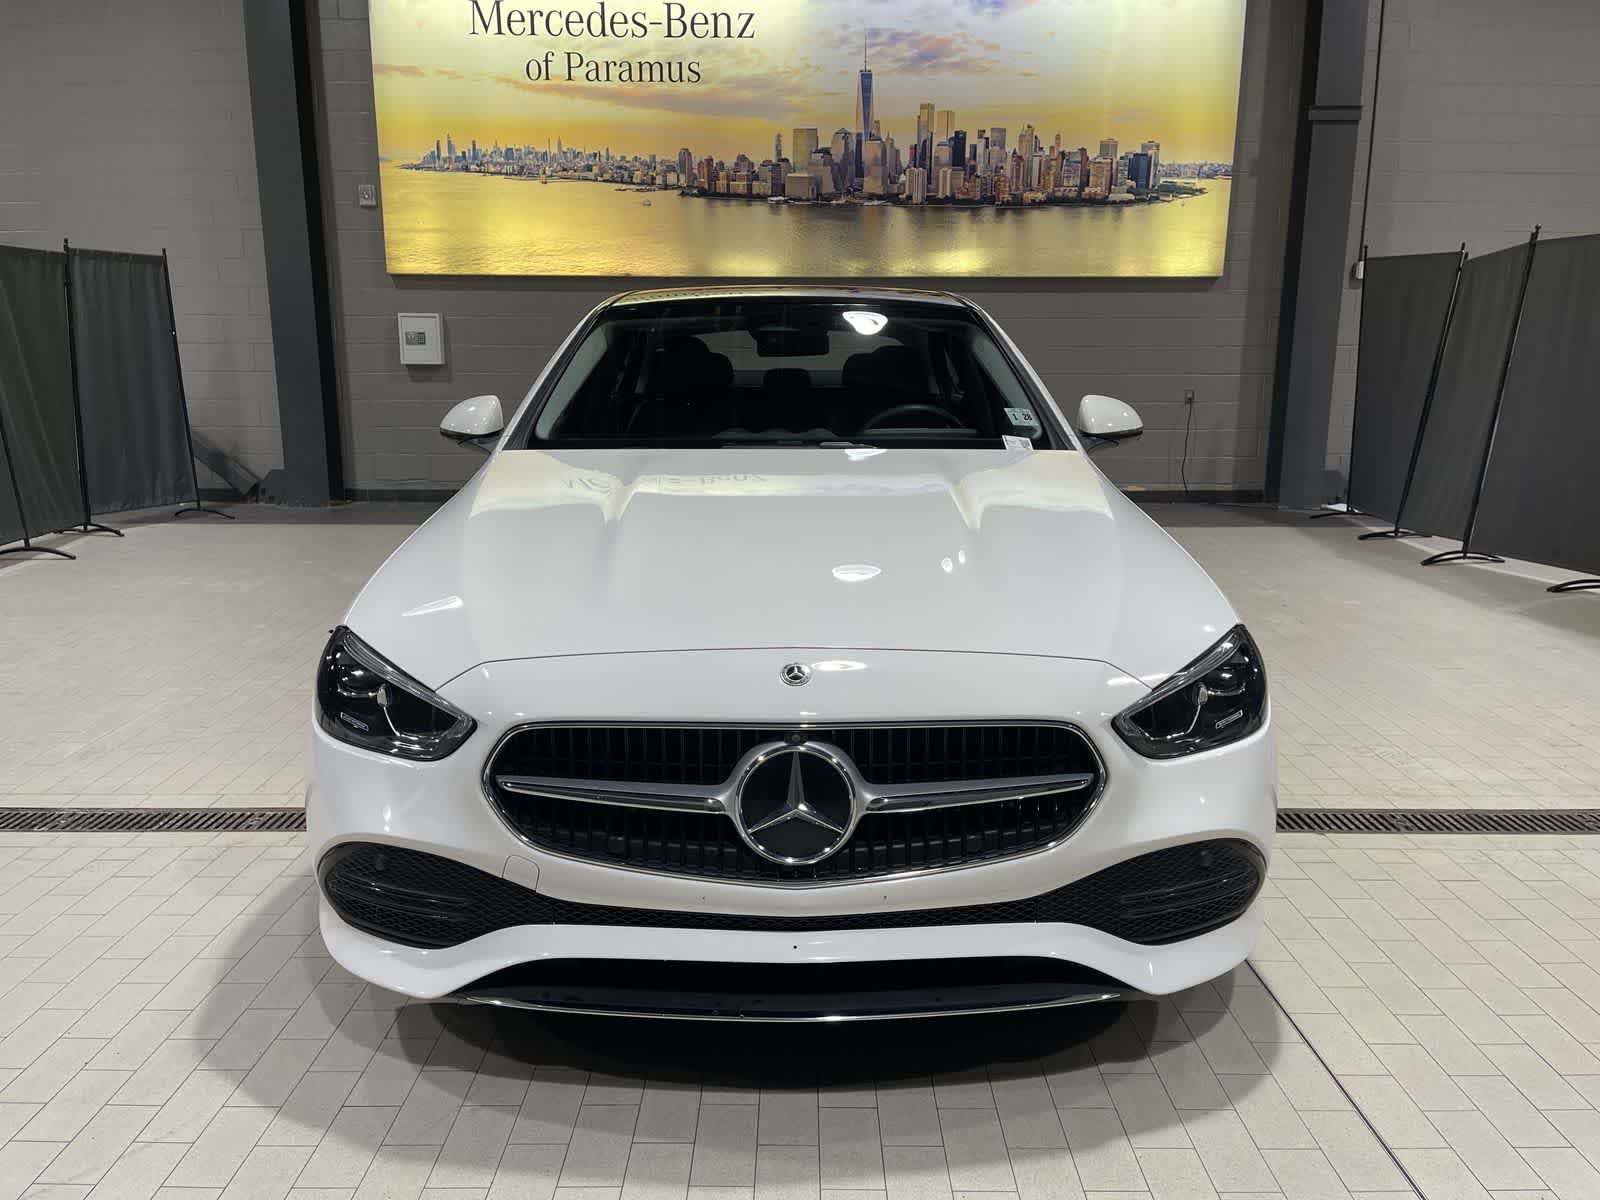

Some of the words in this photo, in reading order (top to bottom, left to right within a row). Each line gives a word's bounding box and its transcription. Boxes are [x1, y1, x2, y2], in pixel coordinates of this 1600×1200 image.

[468, 0, 756, 39] Mercedes-Benz
[525, 51, 555, 81] of
[564, 51, 701, 83] Paramus
